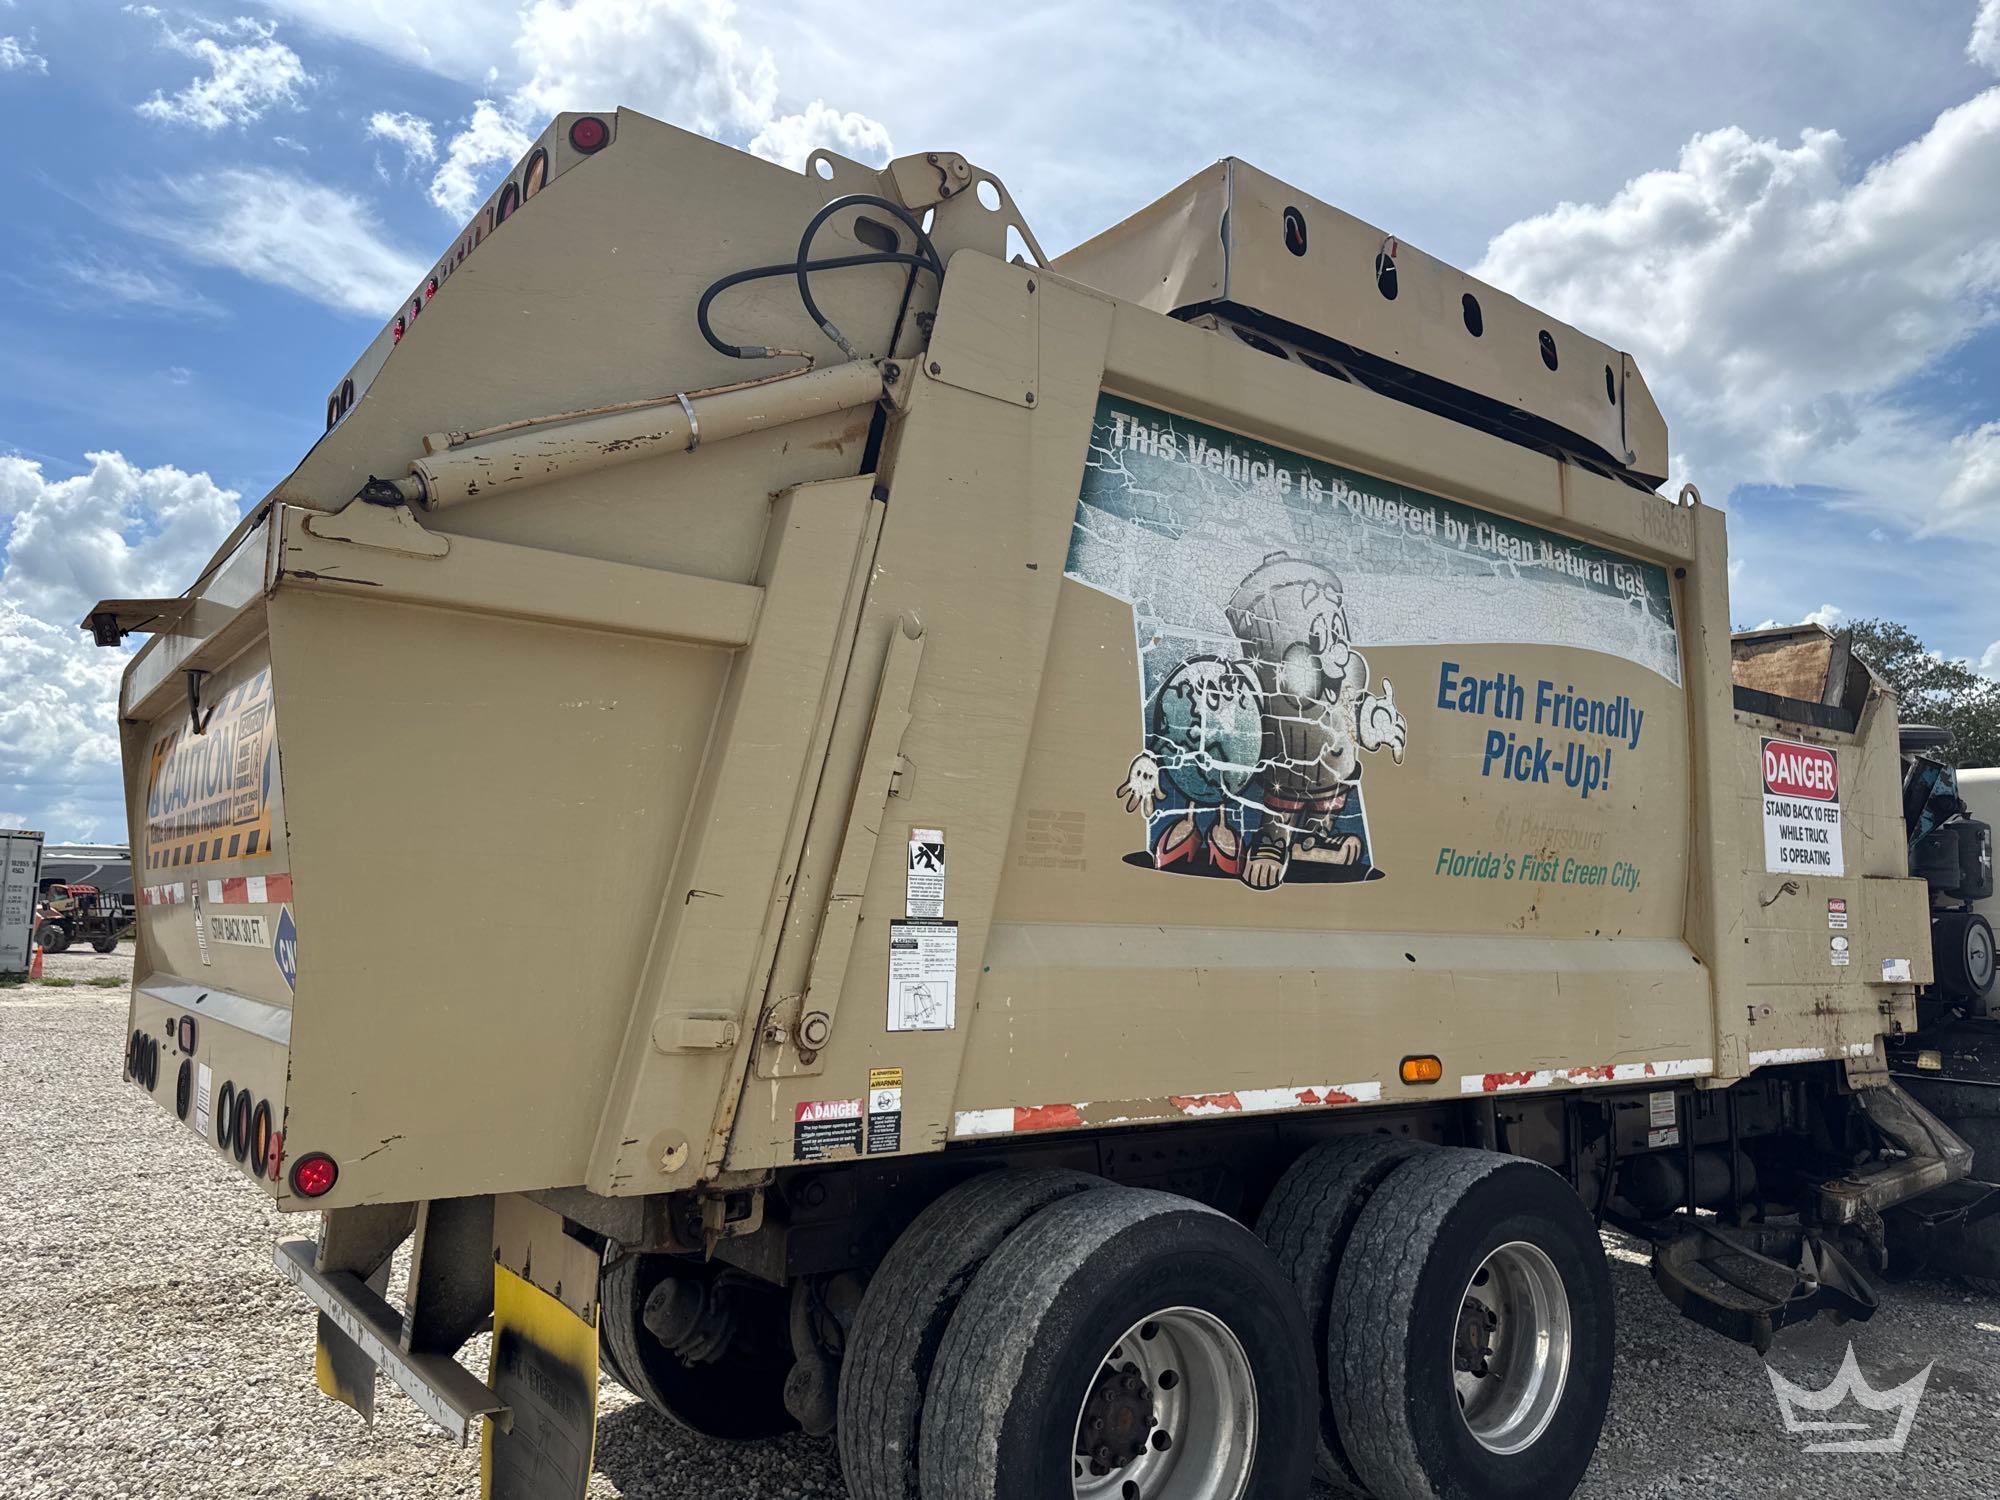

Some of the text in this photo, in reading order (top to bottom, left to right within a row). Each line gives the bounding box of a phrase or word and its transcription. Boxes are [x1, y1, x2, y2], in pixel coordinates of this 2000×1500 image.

[1111, 410, 1650, 598] This Vehicle is Powered by Clean Natural Gas.
[1437, 661, 1645, 750] Earth Friendly
[163, 720, 238, 815] CAUTION
[1482, 729, 1612, 799] Pick-Up!
[1765, 750, 1835, 792] DANGER
[1765, 800, 1839, 824] STAND BACK 10 FEET
[1779, 824, 1829, 844] WHILE TRUCK
[1435, 847, 1641, 893] Florida's First Green City.
[1780, 846, 1831, 866] IS OPERATING
[211, 917, 264, 944] STAY BACK 30 FT.
[279, 938, 297, 974] CN
[875, 1079, 902, 1087] WARNING
[815, 1102, 860, 1119] DANGER
